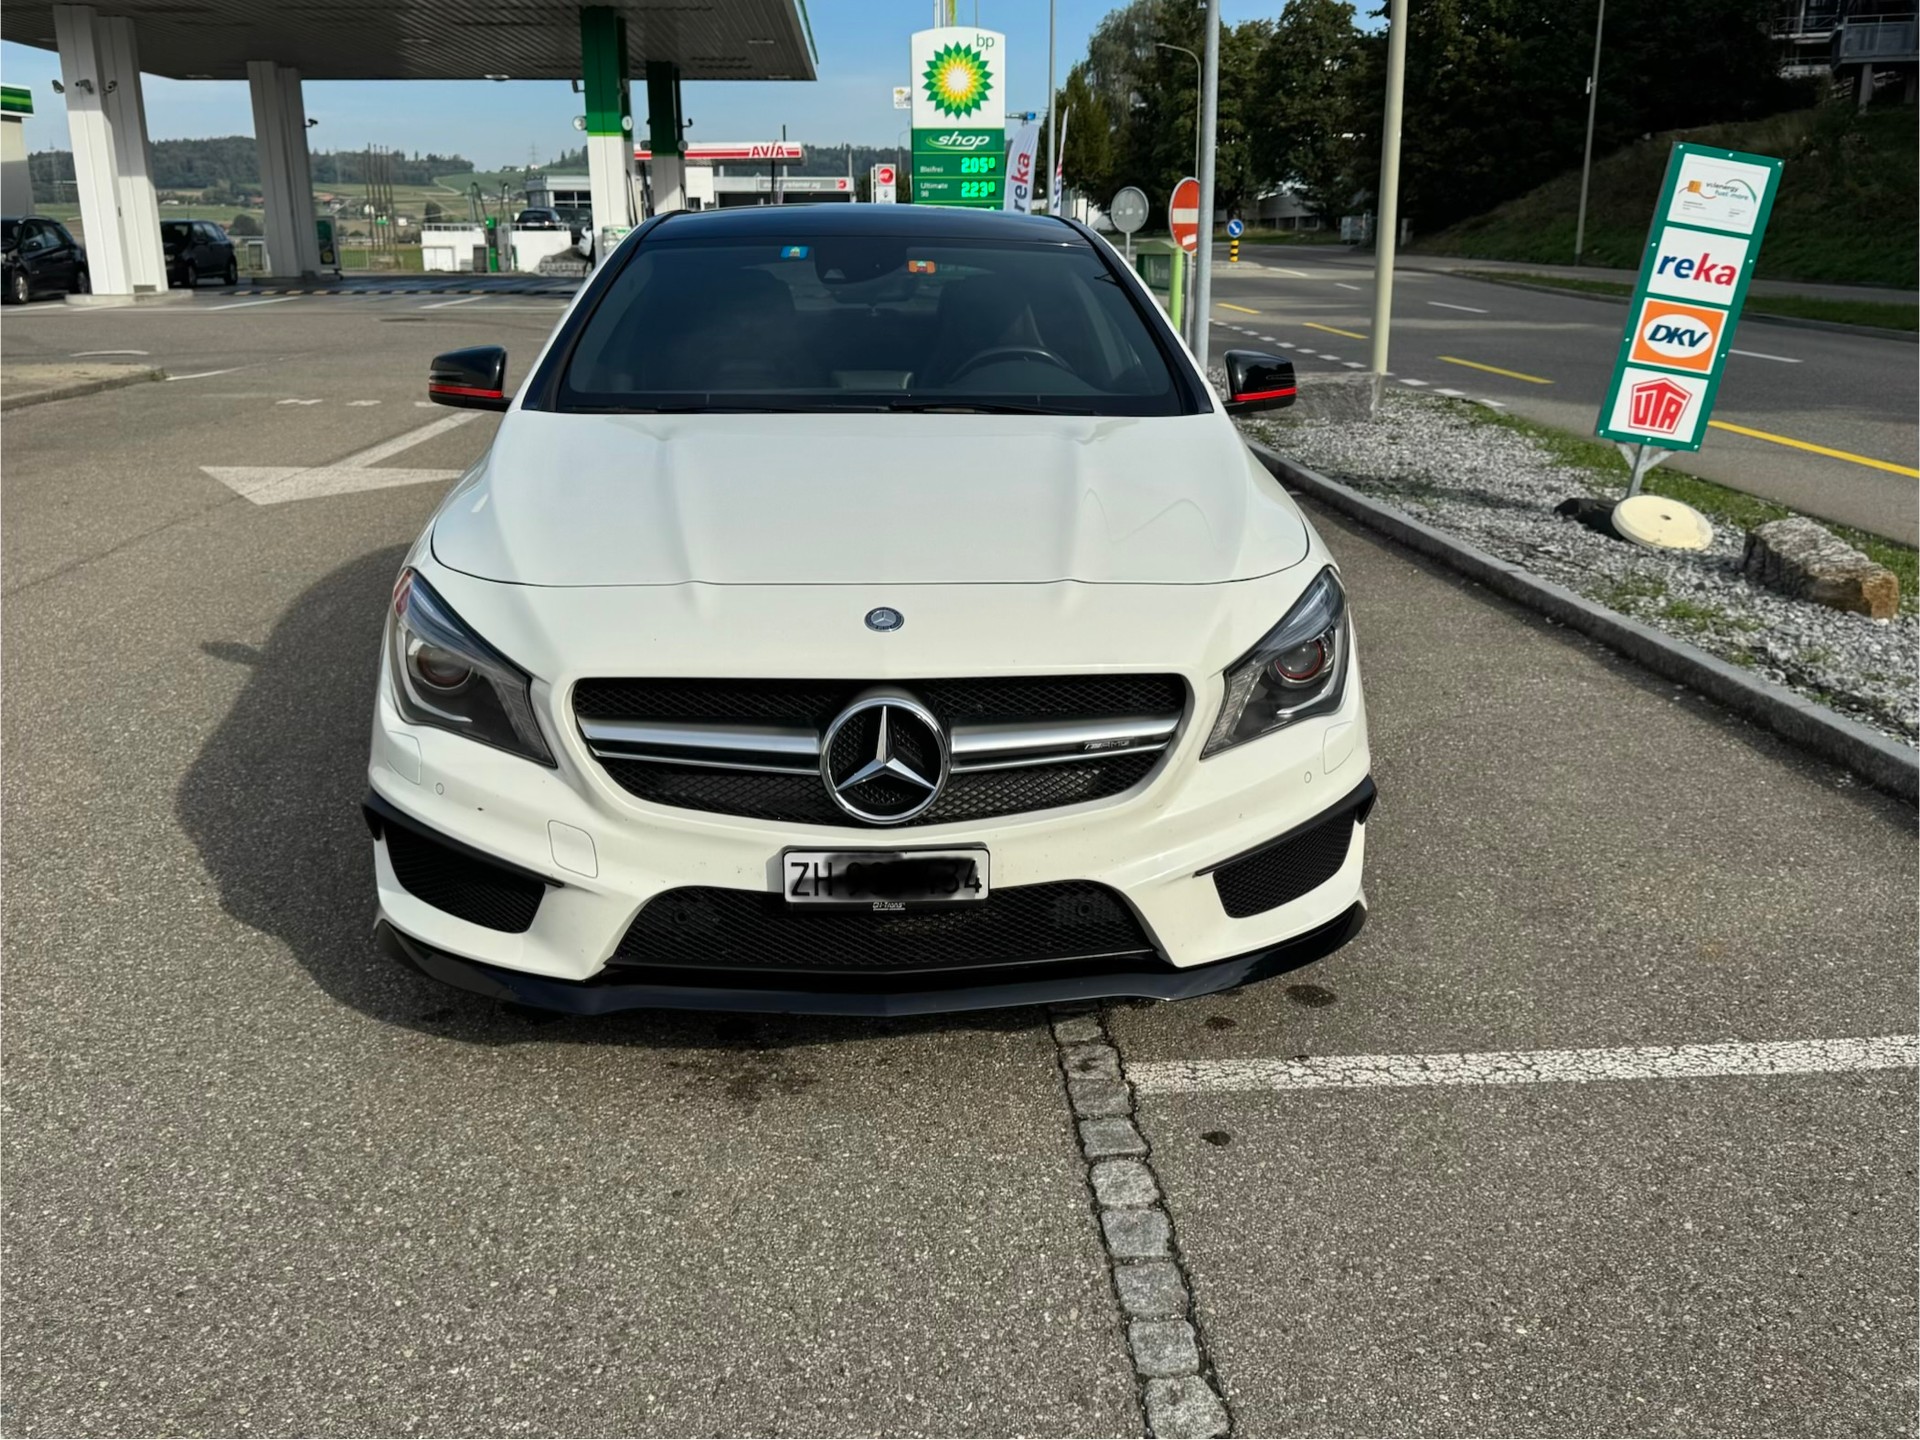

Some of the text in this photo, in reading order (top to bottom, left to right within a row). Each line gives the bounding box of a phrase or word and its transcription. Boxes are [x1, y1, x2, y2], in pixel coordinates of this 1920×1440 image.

[976, 34, 995, 50] bp
[752, 142, 785, 156] AVIA
[936, 131, 990, 149] shop
[1011, 152, 1030, 212] reka
[1657, 252, 1736, 286] reka
[1648, 324, 1709, 348] DKV
[1632, 381, 1690, 430] UTA
[790, 862, 833, 897] ZH
